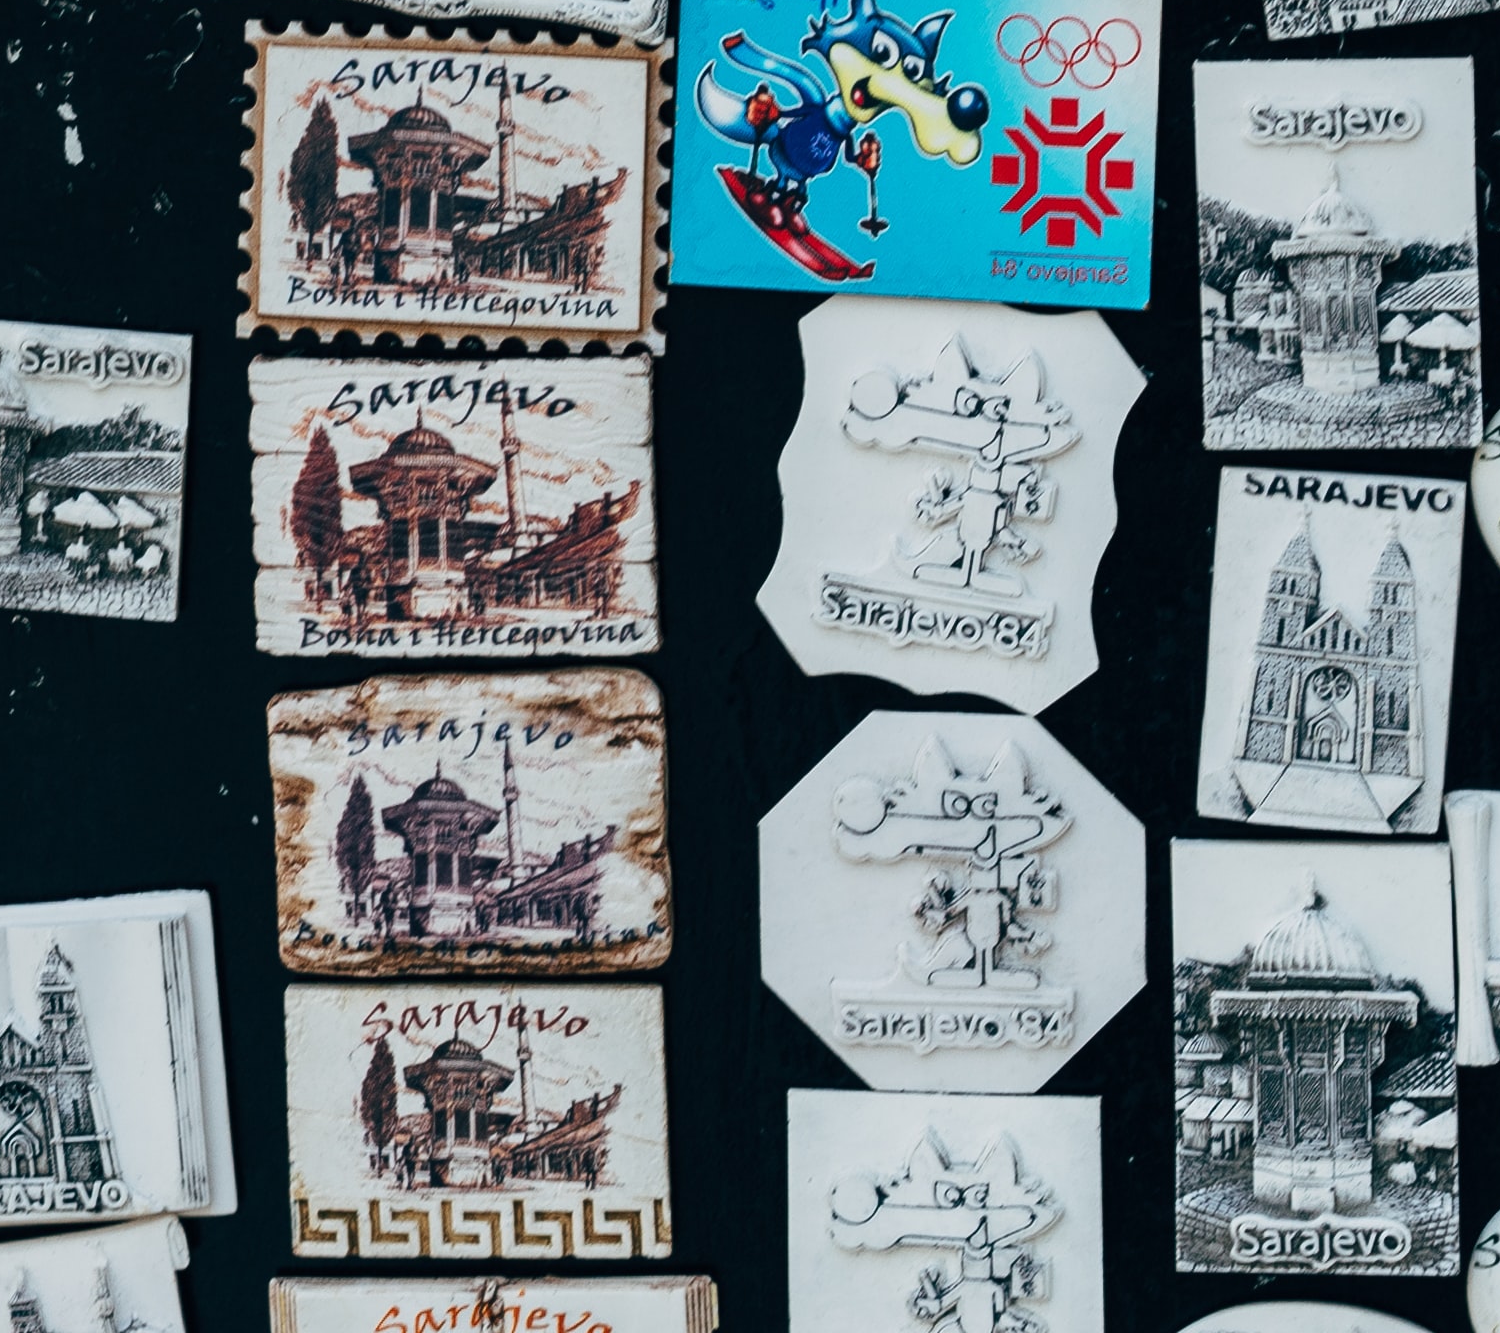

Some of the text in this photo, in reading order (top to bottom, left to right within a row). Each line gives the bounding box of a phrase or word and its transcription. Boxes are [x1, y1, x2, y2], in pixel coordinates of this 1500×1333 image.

[330, 46, 571, 107] Sarajevo
[1249, 100, 1414, 144] Sarajevo
[286, 274, 619, 326] Bosna i Hercegovina
[20, 339, 177, 383] Sarajevo
[327, 362, 576, 427] Sarajevo
[1243, 472, 1455, 513] SARAJEVO
[299, 616, 645, 656] Bosna i Hercegovina
[821, 585, 985, 645] Sarajevo
[346, 708, 575, 760] Sarajevo
[362, 999, 590, 1052] Sarajevo
[840, 1003, 1003, 1050] Sarajevo
[1238, 1220, 1405, 1264] Sarajevo
